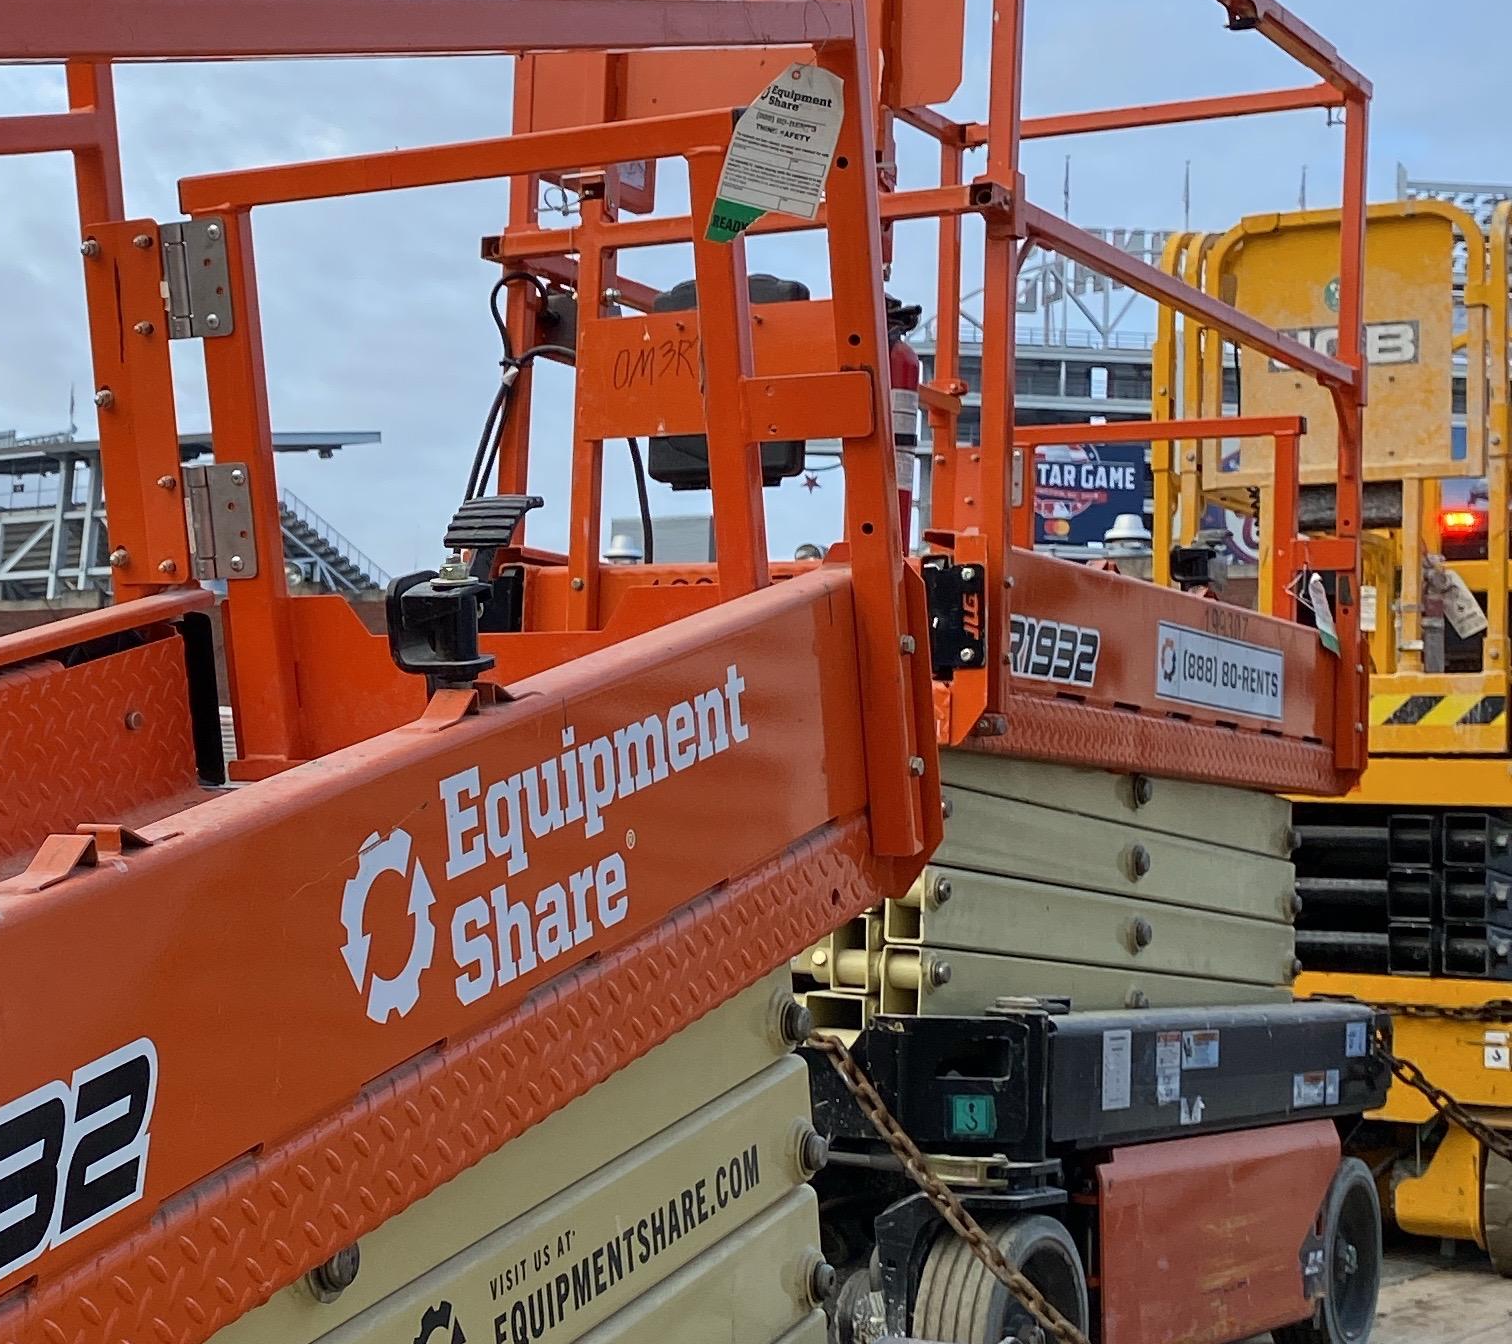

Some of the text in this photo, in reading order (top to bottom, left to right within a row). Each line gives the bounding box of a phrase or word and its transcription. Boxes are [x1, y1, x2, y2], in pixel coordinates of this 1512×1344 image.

[768, 96, 800, 112] Share
[771, 85, 832, 108] Equipment
[1037, 463, 1136, 490] TAR GAME
[1182, 649, 1279, 698] (888) 80-RENTS
[439, 664, 750, 881] Equipment
[450, 852, 629, 1006] Share
[489, 1259, 528, 1302] VISIT
[533, 1244, 551, 1273] US
